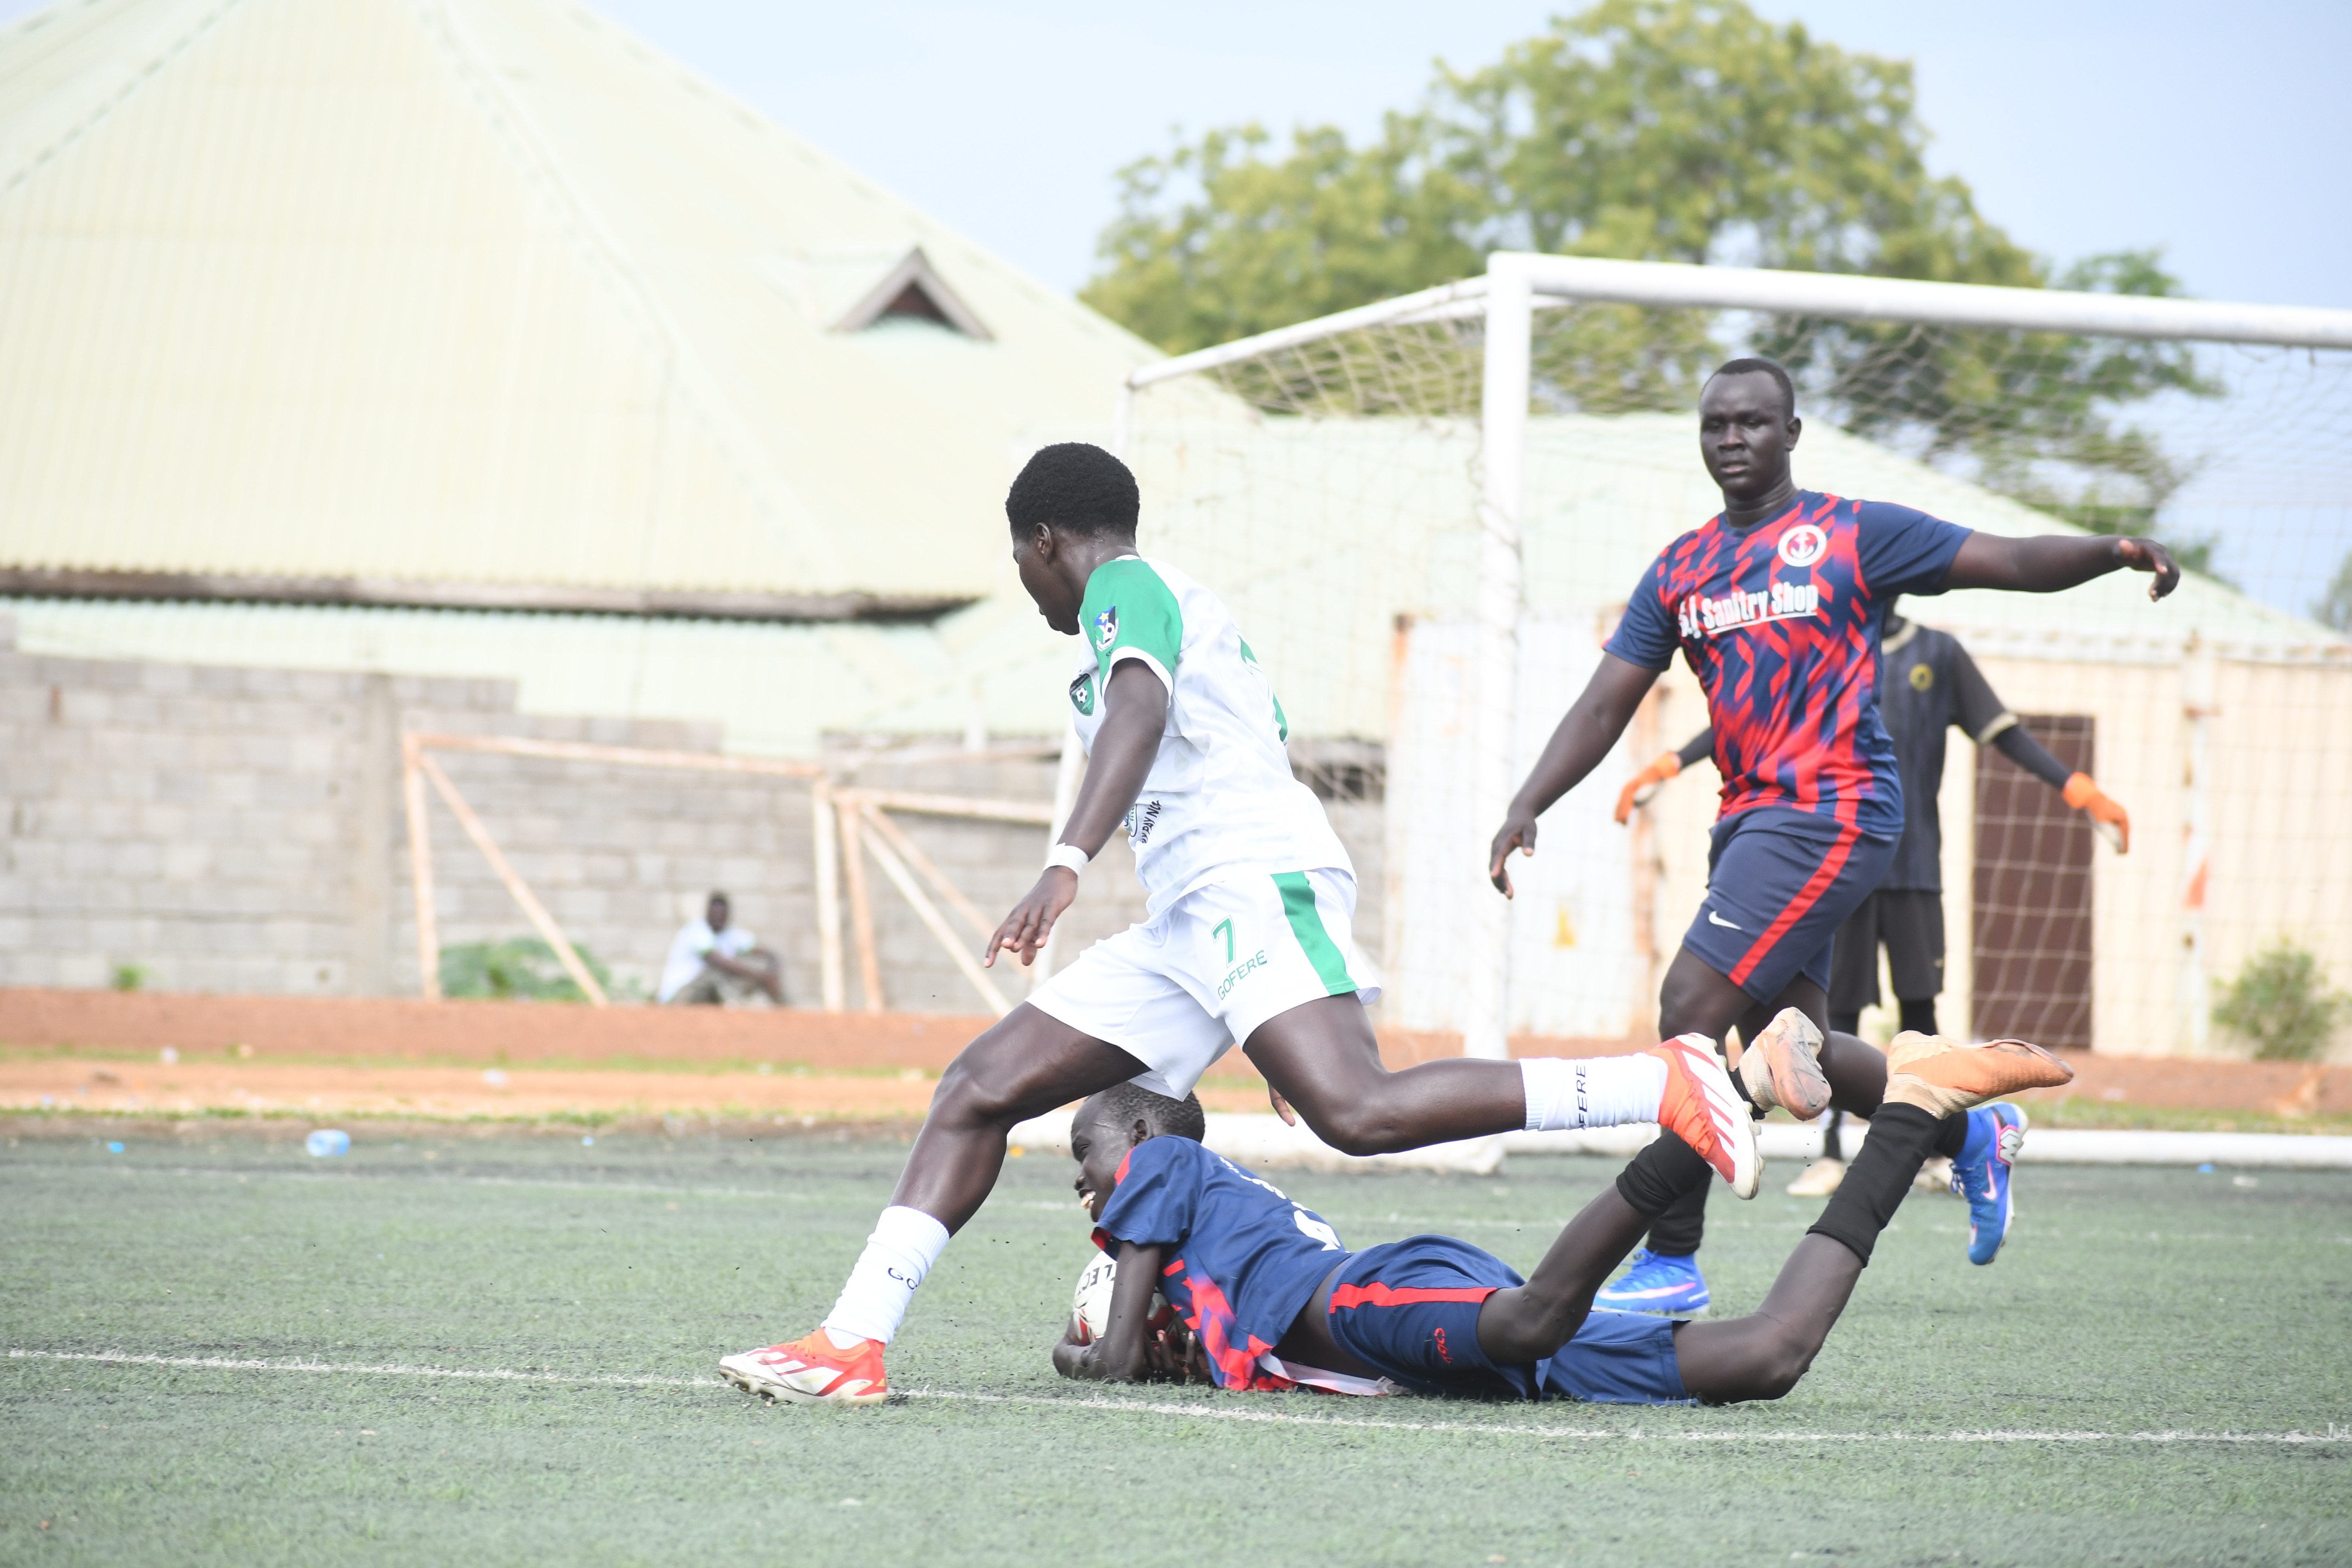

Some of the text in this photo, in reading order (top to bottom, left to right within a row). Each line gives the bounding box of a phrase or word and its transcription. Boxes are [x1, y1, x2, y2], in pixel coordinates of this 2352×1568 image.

[1701, 591, 1769, 629] Sanitry
[1771, 581, 1818, 615] Shop
[1142, 817, 1155, 835] PAY
[1211, 915, 1236, 968] 7
[1217, 950, 1267, 1001] GOFERE
[1576, 1065, 1587, 1127] FERE
